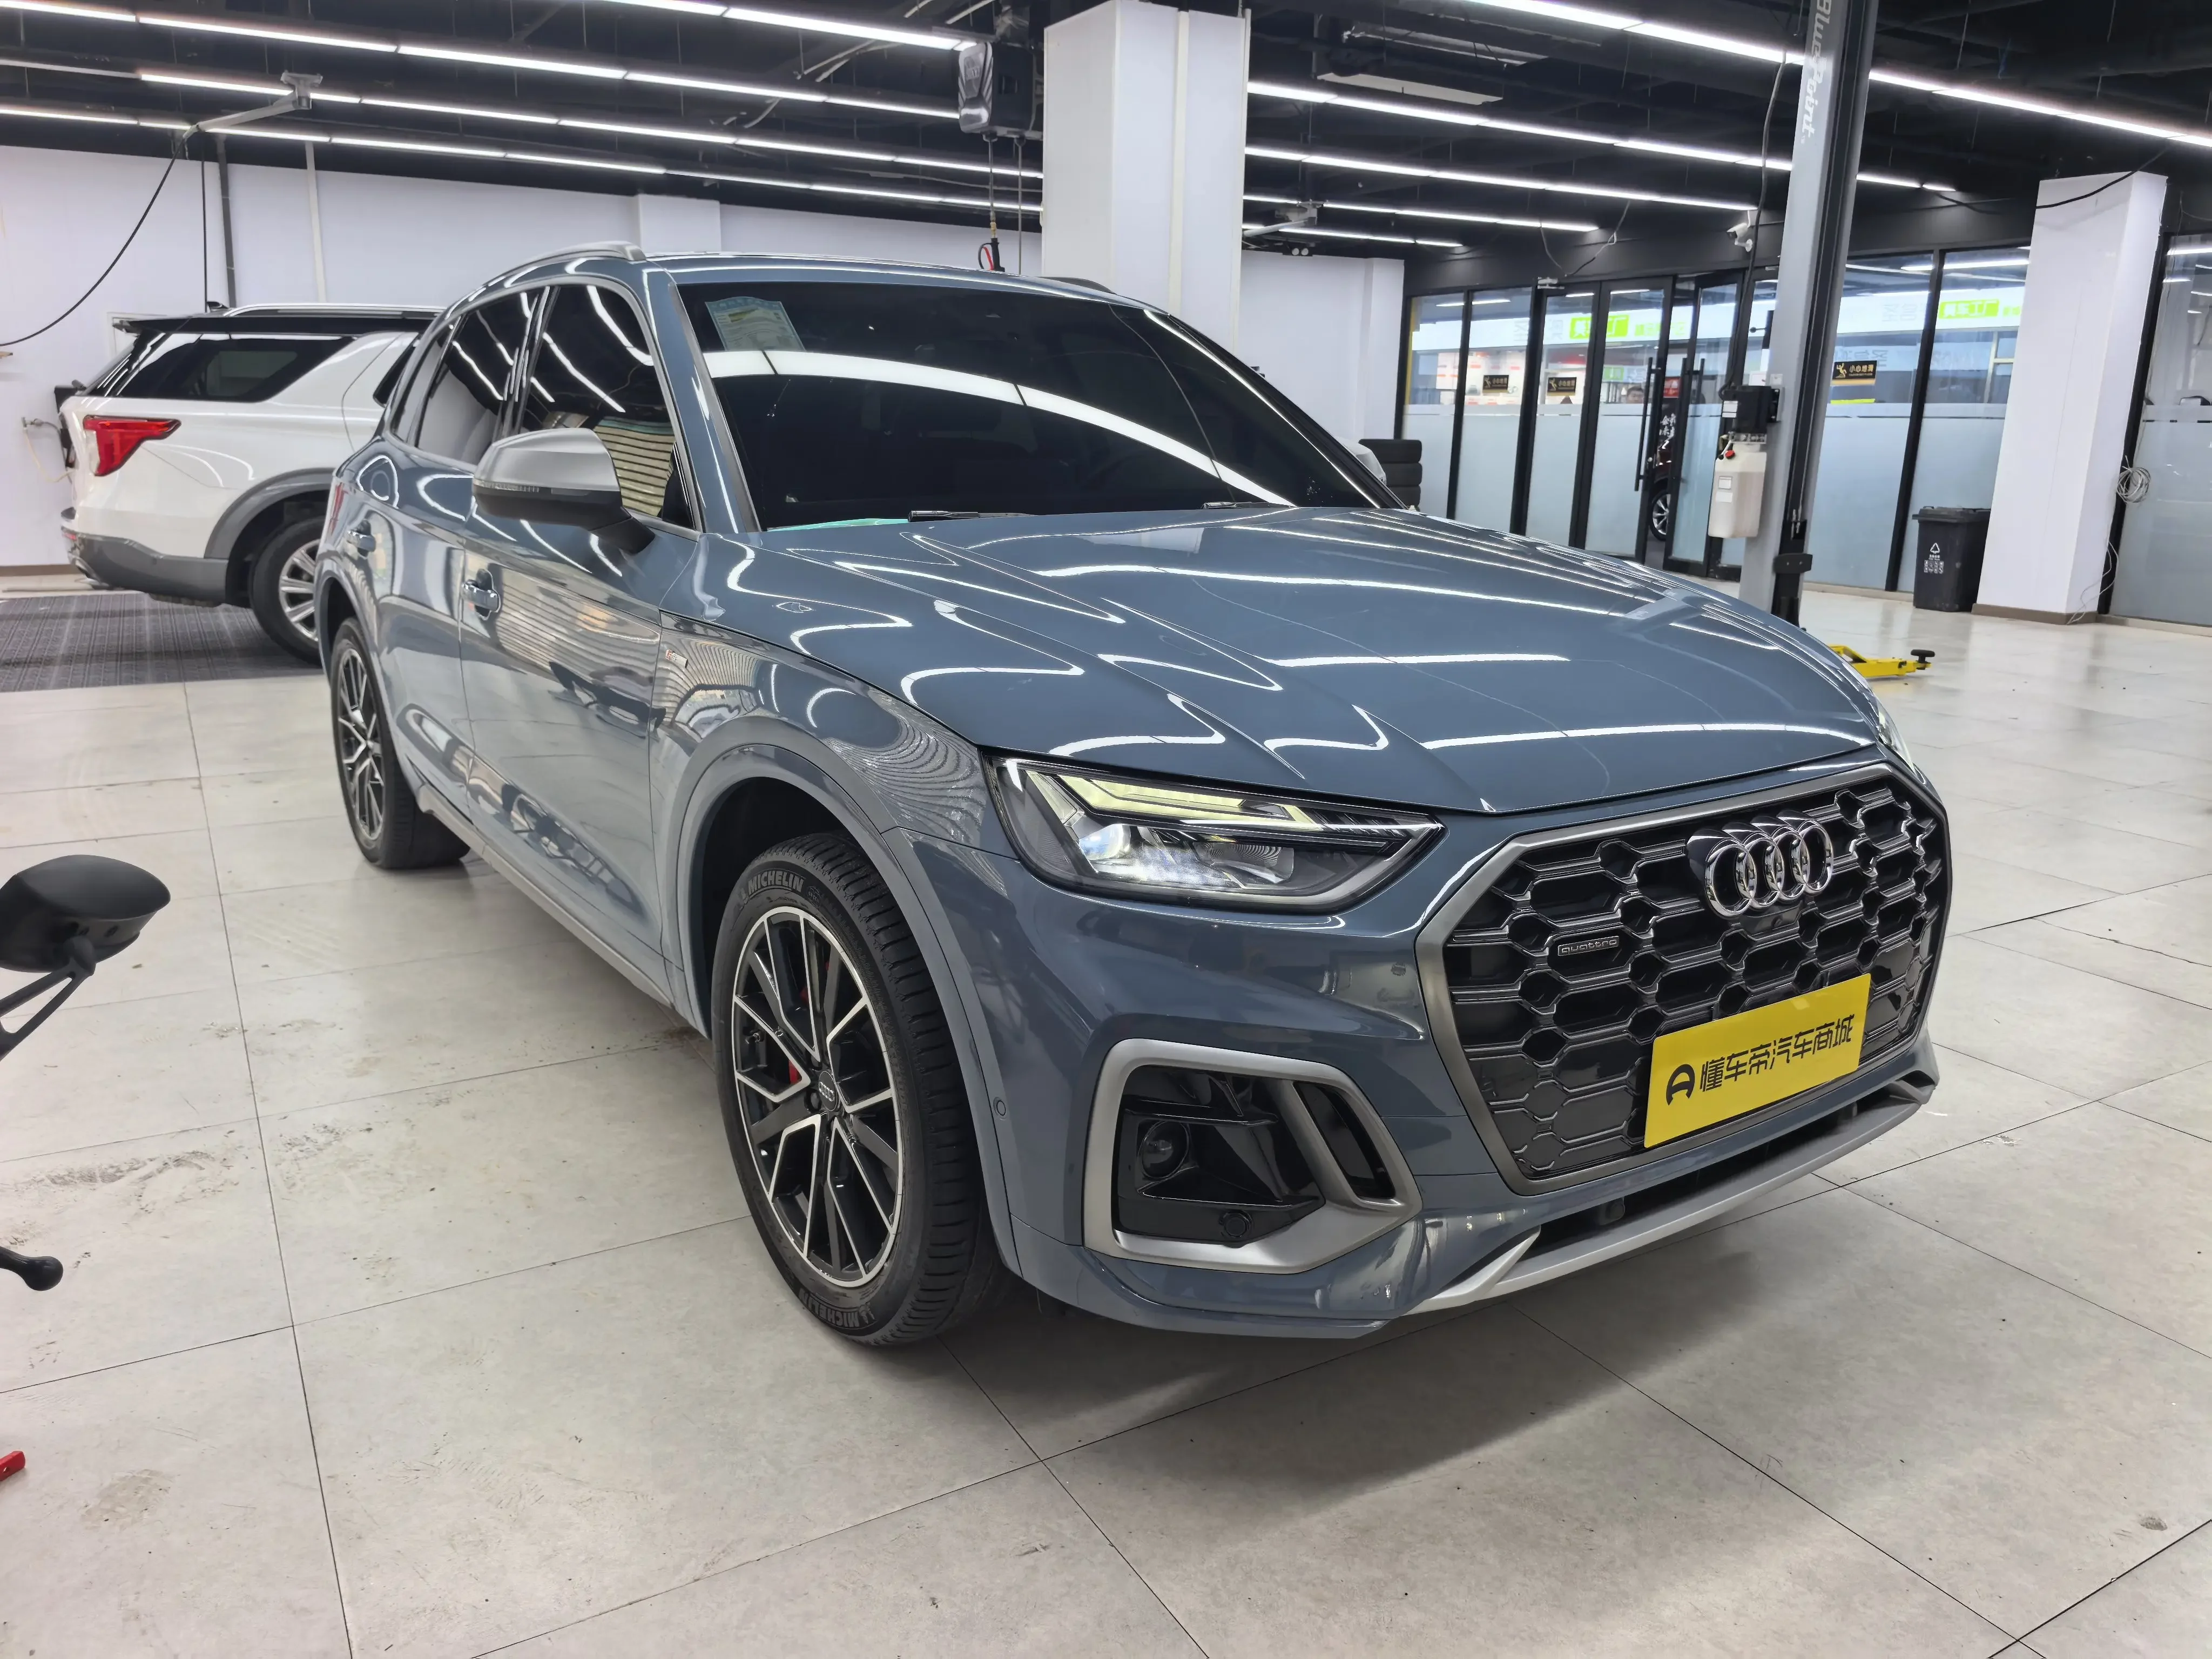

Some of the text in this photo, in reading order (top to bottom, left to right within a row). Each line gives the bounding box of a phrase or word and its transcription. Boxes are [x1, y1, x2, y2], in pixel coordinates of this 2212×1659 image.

[748, 871, 804, 895] MICHELIN
[1561, 939, 1617, 955] quattro
[1699, 1014, 1855, 1092] 懂车帝汽车商城
[798, 1288, 860, 1328] MICHELIN
